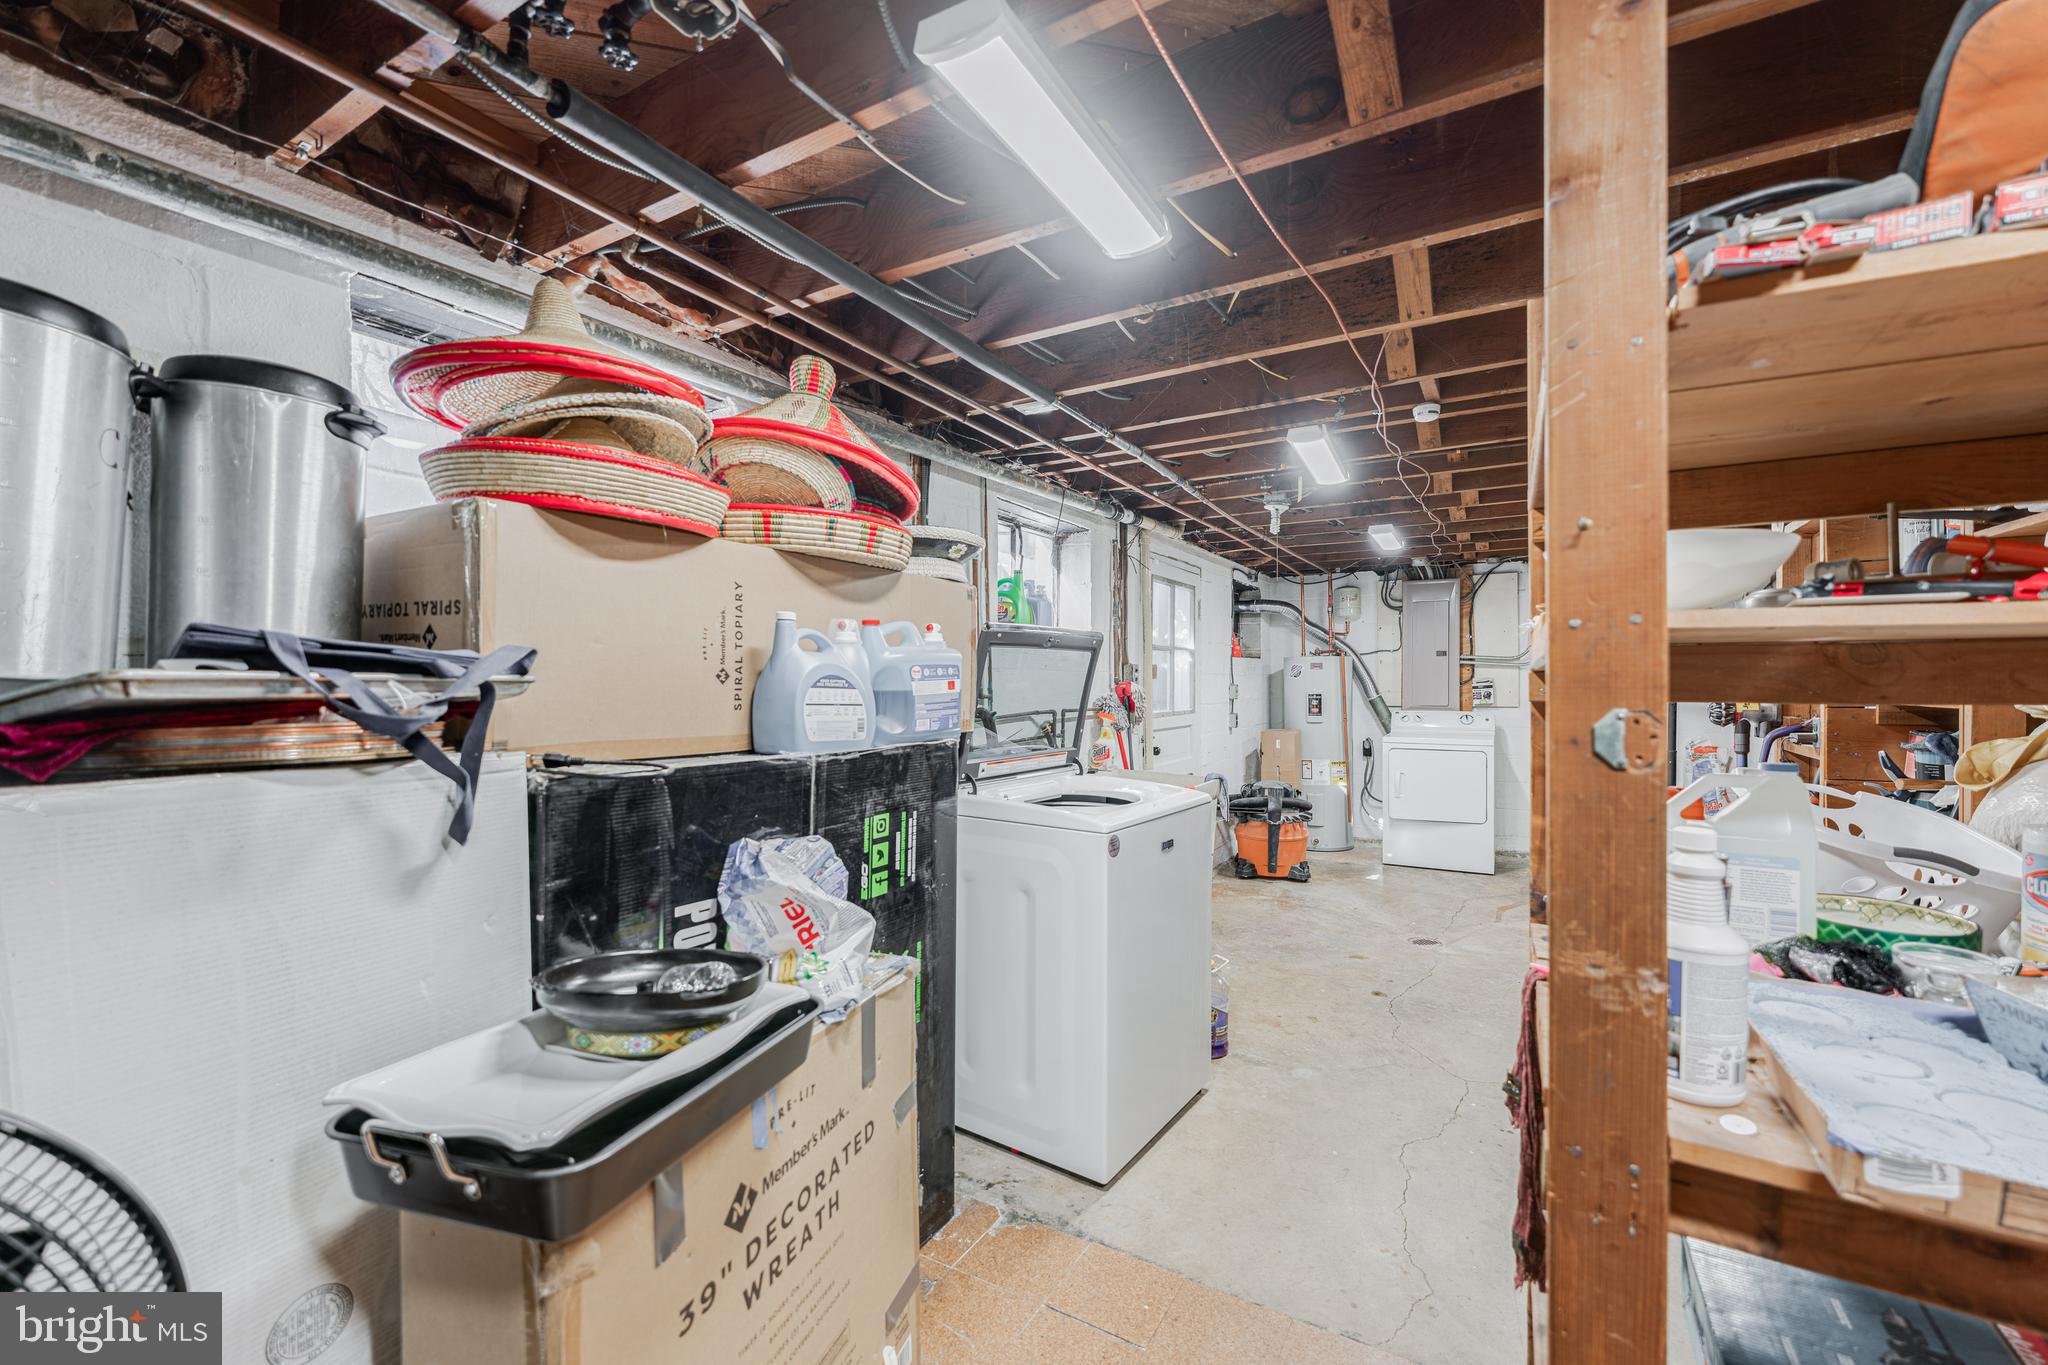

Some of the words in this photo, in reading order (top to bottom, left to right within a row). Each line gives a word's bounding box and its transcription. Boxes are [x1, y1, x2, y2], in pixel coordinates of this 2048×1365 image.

[360, 602, 410, 619] TOPIARY
[413, 599, 462, 617] SPIRAL
[734, 581, 743, 650] TOPIARY
[733, 656, 743, 711] SPIRAL
[673, 898, 718, 950] PO
[769, 1083, 817, 1130] PRE-LIT
[761, 1131, 818, 1195] Member's
[678, 1261, 732, 1338] 39"
[745, 1120, 876, 1268] DECORATED
[742, 1190, 840, 1312] WREATH
